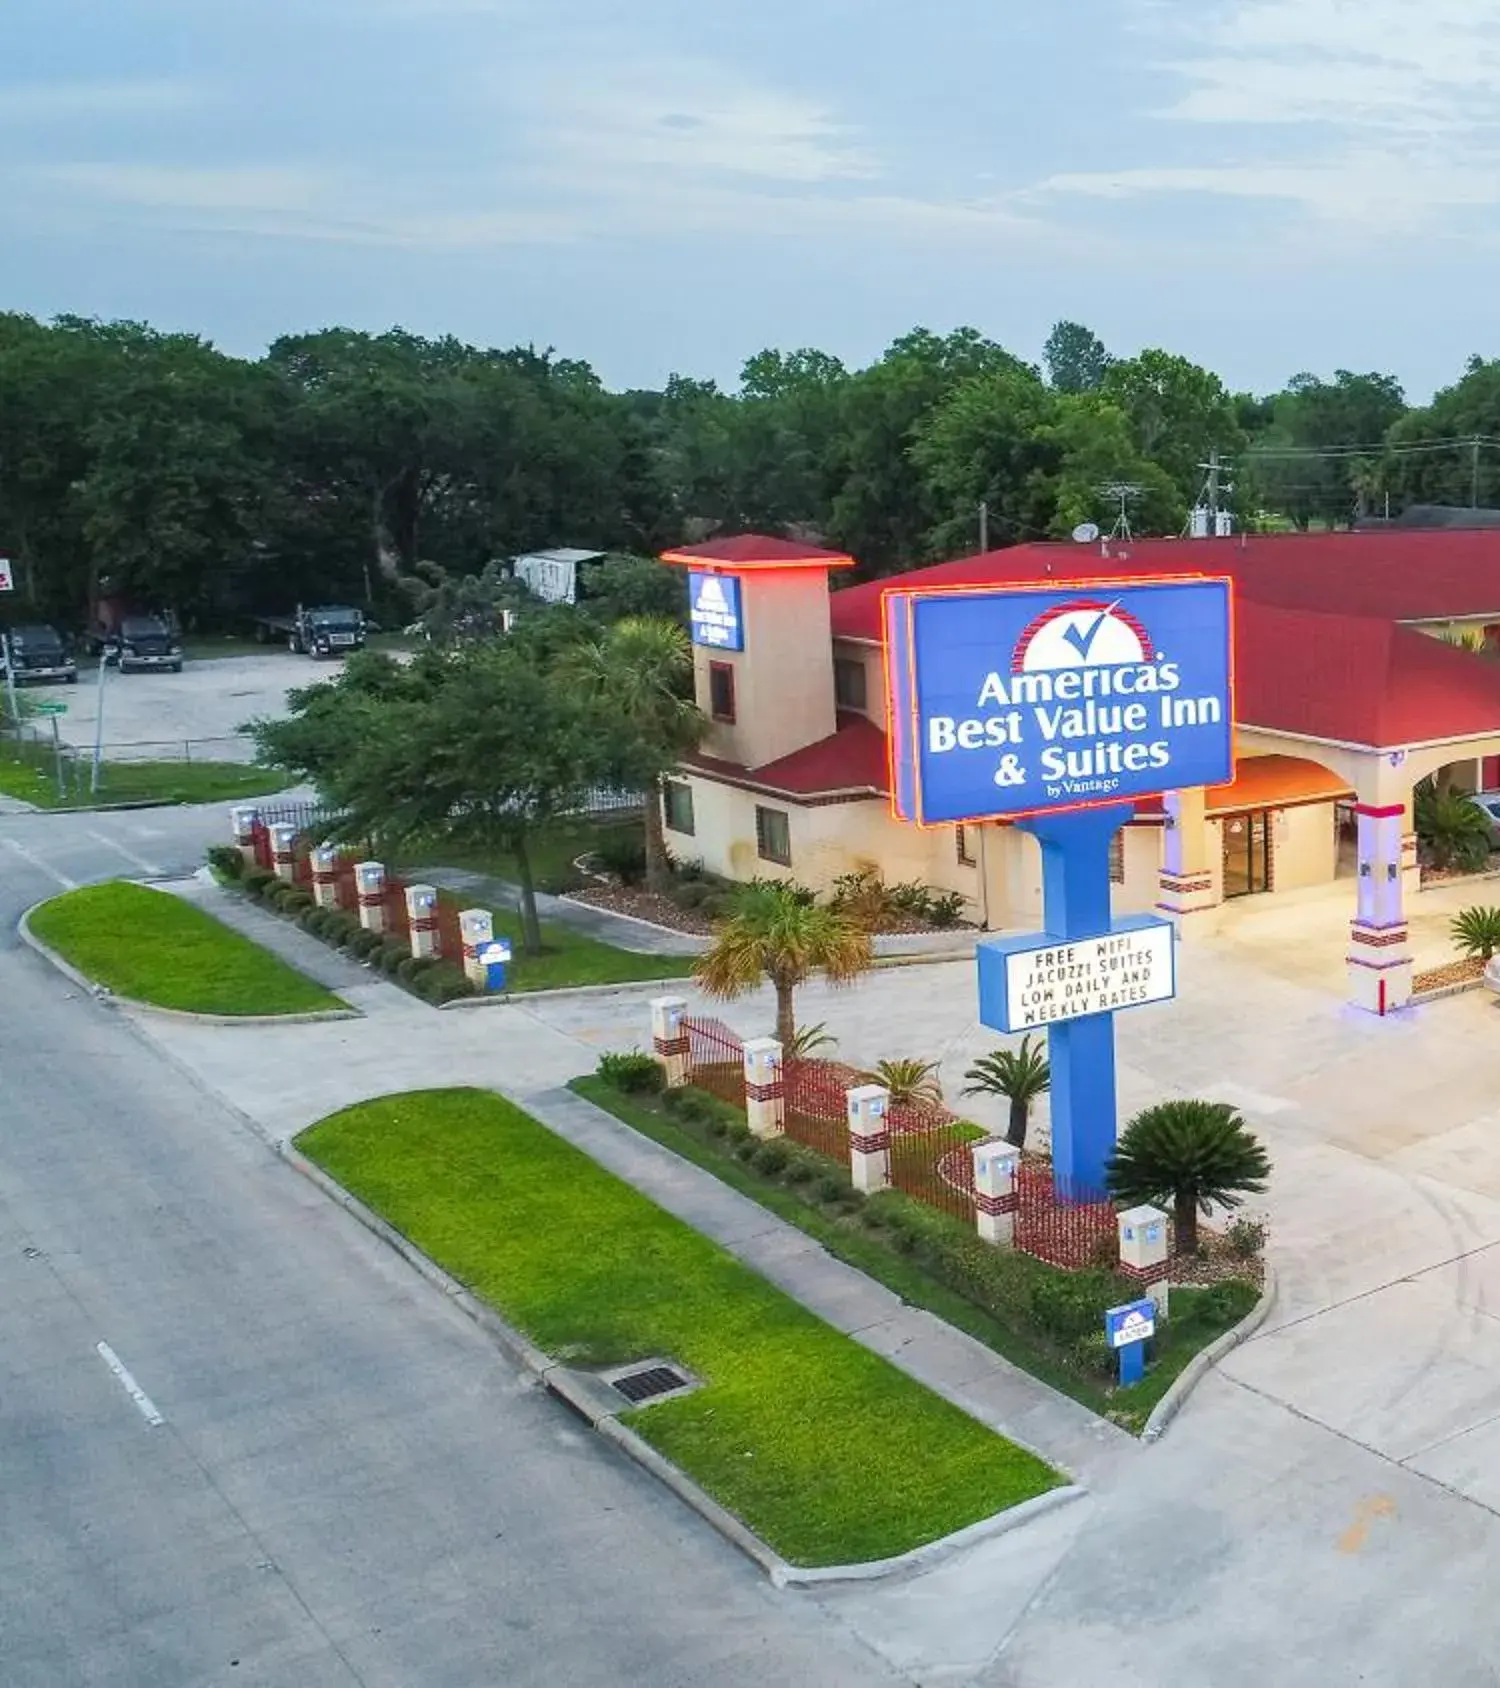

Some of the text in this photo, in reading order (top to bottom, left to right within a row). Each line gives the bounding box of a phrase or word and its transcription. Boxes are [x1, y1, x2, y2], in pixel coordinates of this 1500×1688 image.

[977, 661, 1180, 708] Americas
[929, 695, 1221, 753] Best Value Inn
[993, 739, 1169, 787] & Suites
[1047, 777, 1119, 799] by Vantage
[1025, 949, 1153, 989] JACUZZI SUITES
[1035, 948, 1075, 969] FREE
[1021, 968, 1151, 1007] LOW DAILY AND
[1024, 985, 1148, 1025] WEEKLY RATES
